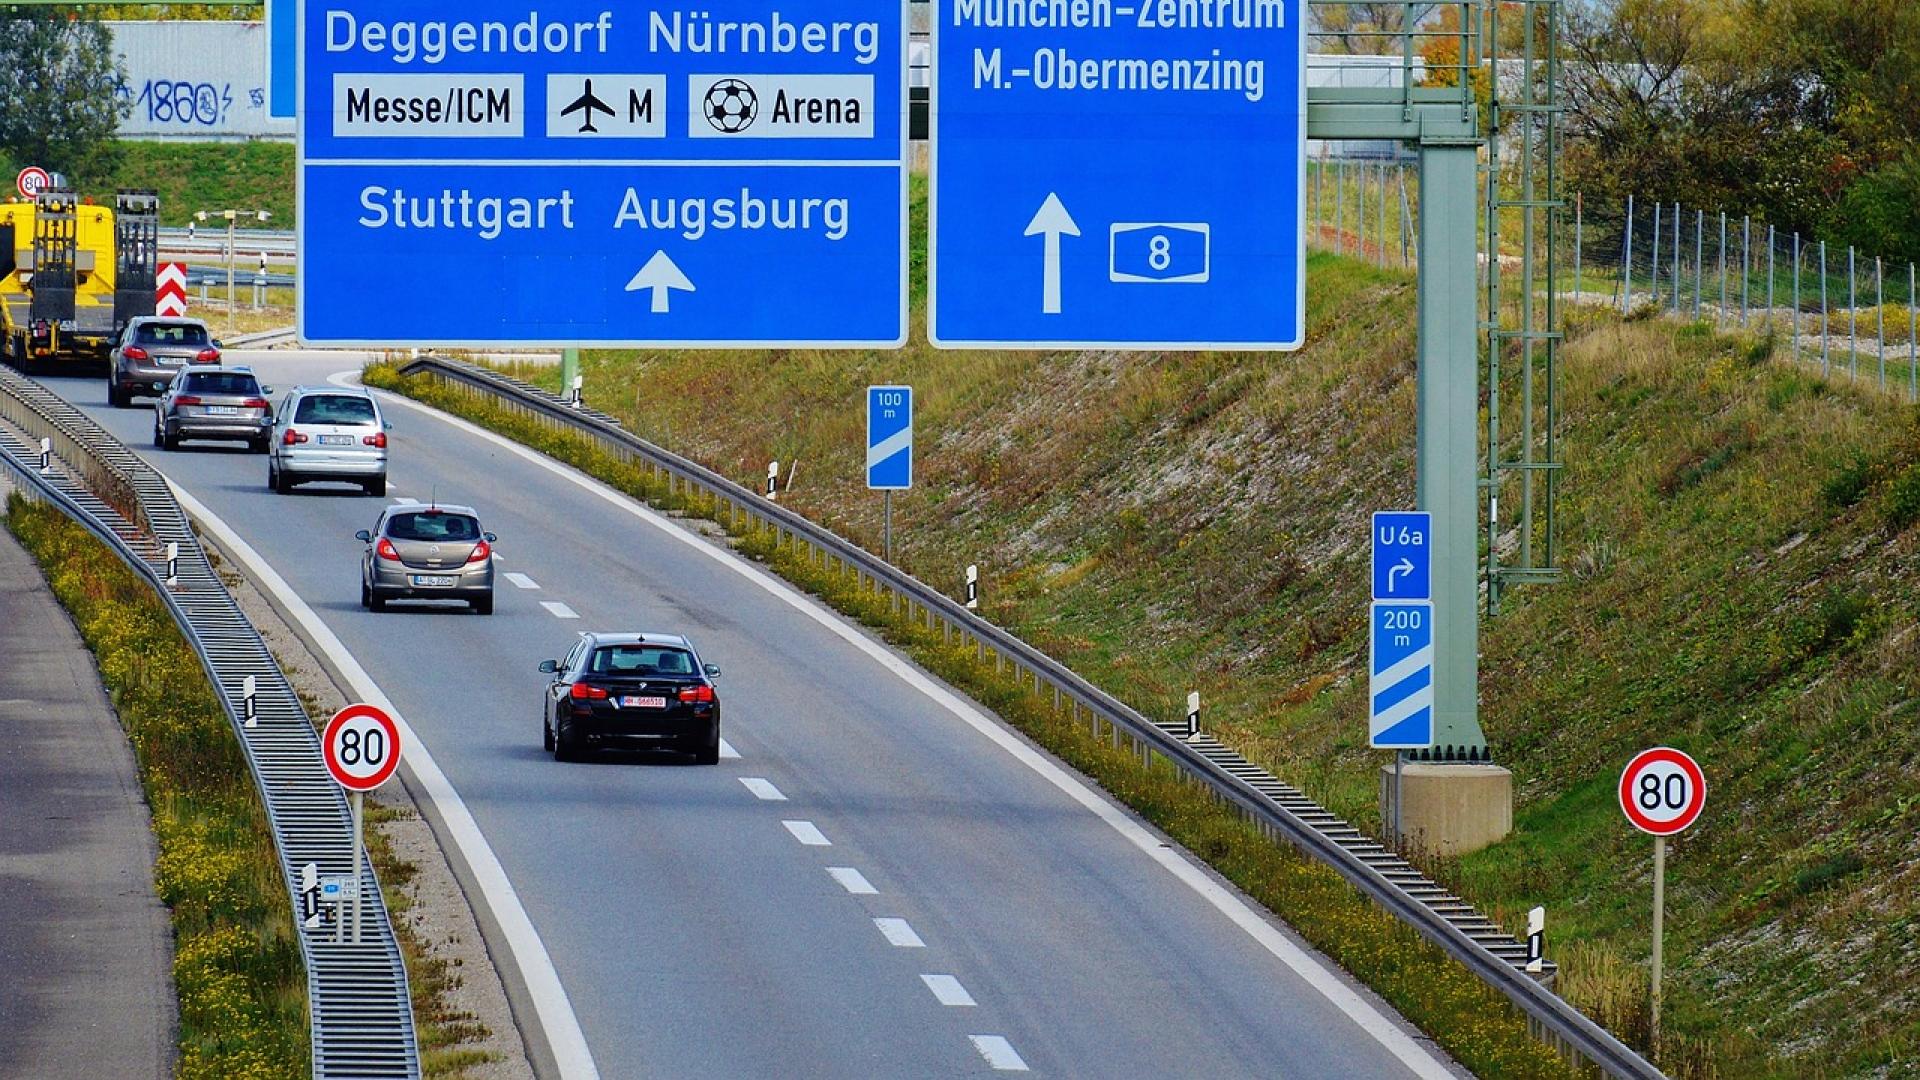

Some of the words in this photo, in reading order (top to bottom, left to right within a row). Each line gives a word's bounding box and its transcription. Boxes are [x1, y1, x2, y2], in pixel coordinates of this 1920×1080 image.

[326, 11, 612, 65] Deggendorf
[649, 11, 879, 65] Nürnberg
[974, 48, 1264, 102] M.-Obermenzing
[347, 88, 511, 124] Messe/ICM
[629, 88, 653, 124] M
[772, 90, 861, 124] Arena
[25, 176, 43, 190] 80
[359, 186, 574, 240] Stuttgart
[614, 187, 849, 241] Augsburg
[1148, 234, 1171, 271] 8
[878, 392, 902, 407] 100
[884, 409, 896, 419] m
[1398, 525, 1423, 546] 6a
[1383, 610, 1422, 630] 200
[1393, 634, 1411, 647] m
[340, 728, 384, 766] 80
[1639, 773, 1685, 811] 80
